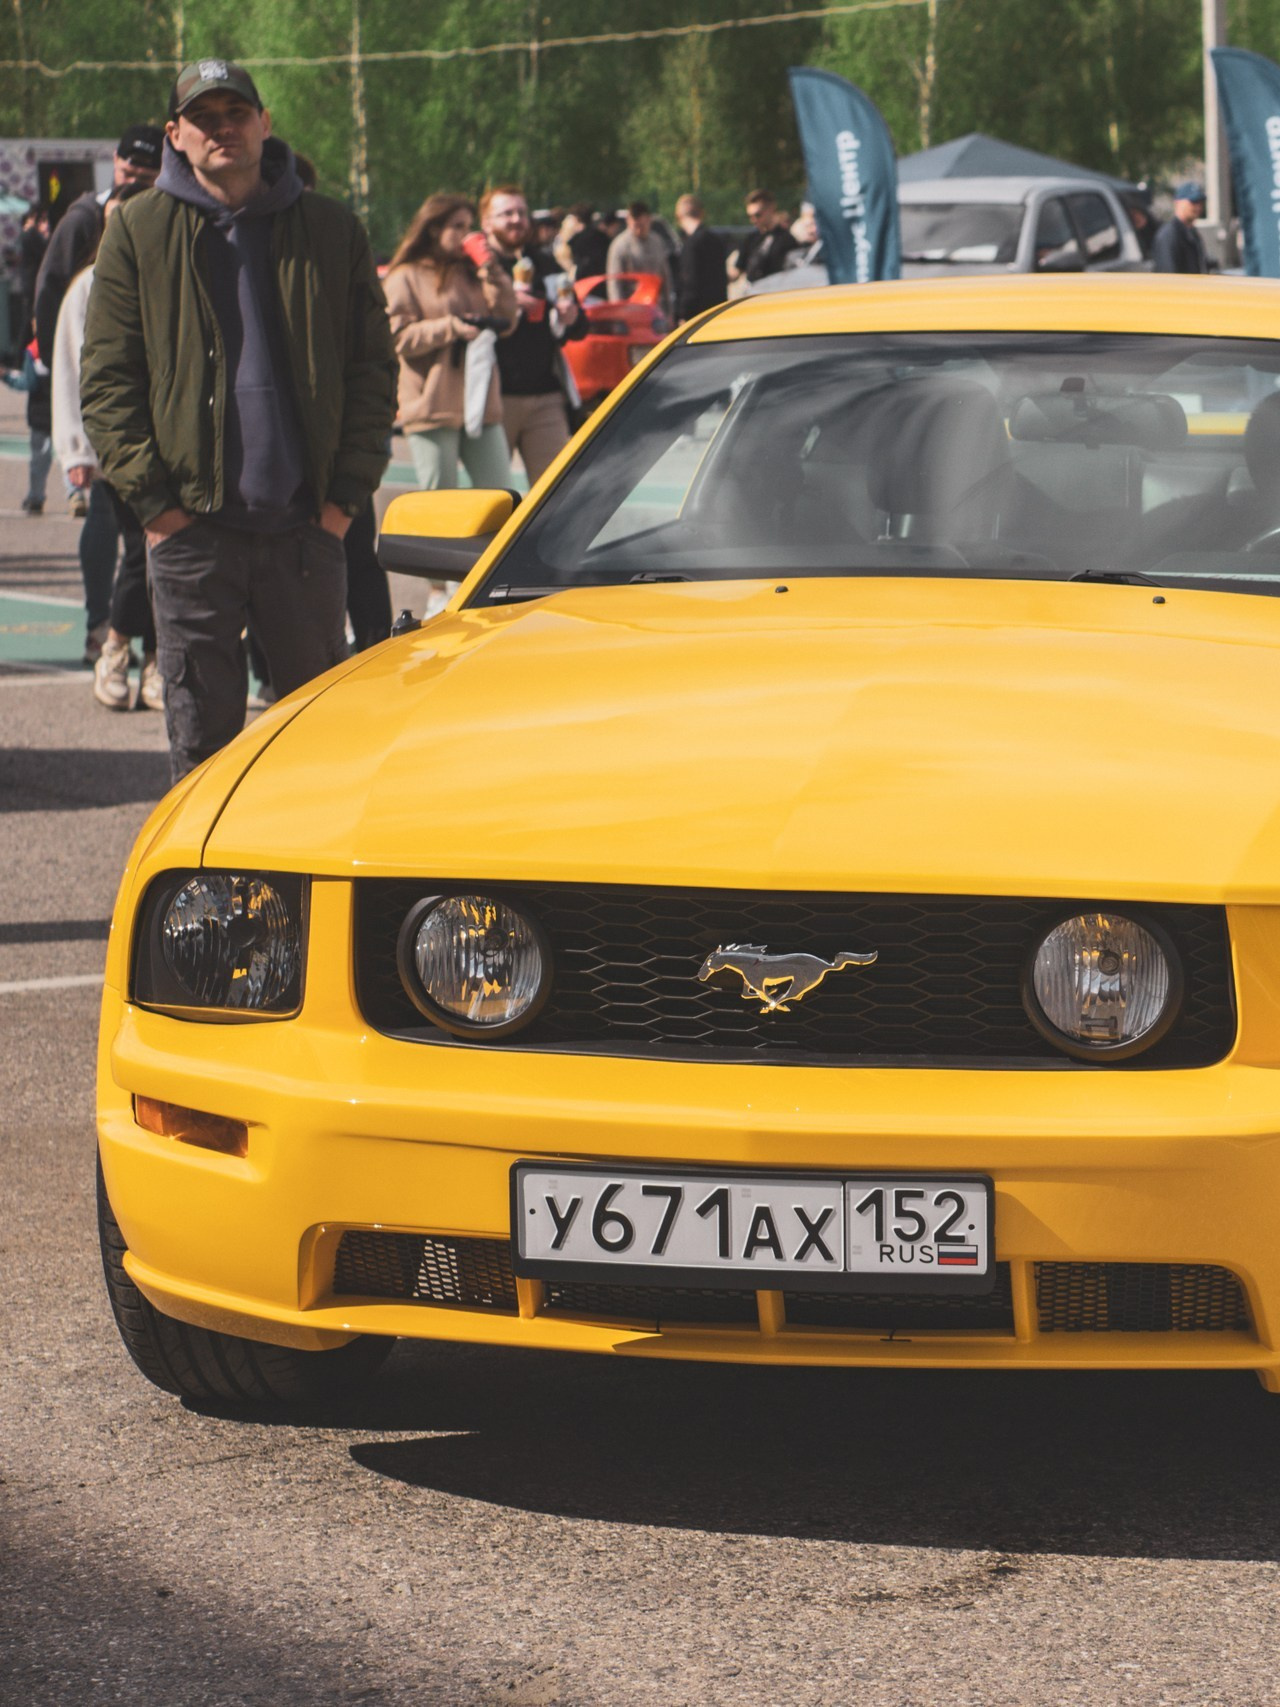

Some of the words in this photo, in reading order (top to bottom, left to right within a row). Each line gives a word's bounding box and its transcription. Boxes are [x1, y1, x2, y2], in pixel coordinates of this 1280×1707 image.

[836, 130, 865, 219] Центр
[855, 1189, 966, 1243] 152
[879, 1243, 935, 1264] RUS
